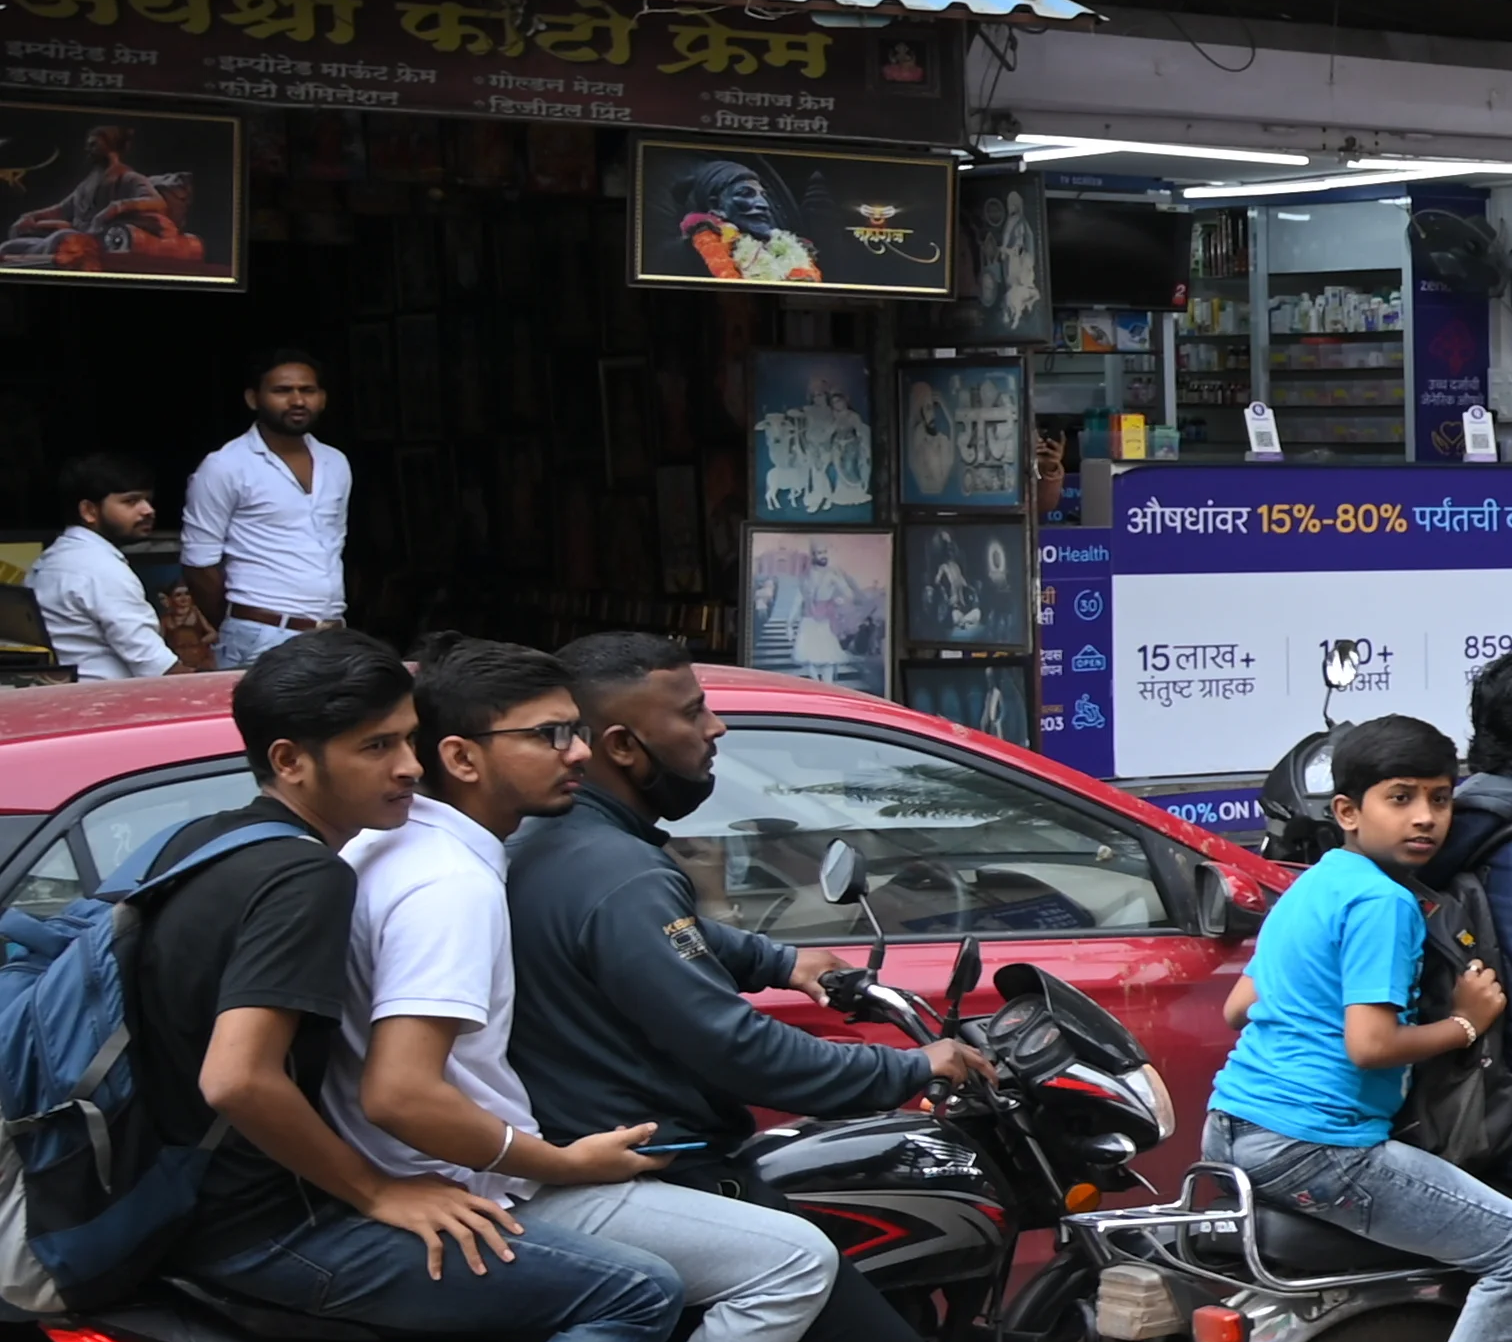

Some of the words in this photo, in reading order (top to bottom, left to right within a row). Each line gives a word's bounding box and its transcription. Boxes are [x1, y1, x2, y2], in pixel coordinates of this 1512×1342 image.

[110, 42, 158, 66] फ्रेम
[656, 6, 834, 79] फ्रेम
[80, 67, 125, 90] फ्रेम
[218, 53, 314, 80] इम्पोटेड
[321, 59, 388, 84] माऊंट
[395, 62, 437, 86] फ्रेम
[219, 77, 279, 99] फोटो
[286, 82, 399, 107] लॅमिनेशन
[488, 72, 563, 95] गोल्डन
[569, 76, 624, 98] मेटल
[489, 95, 583, 119] डिजीटल
[590, 99, 632, 123] प्रिंट
[713, 86, 792, 110] कोलाज
[796, 90, 834, 114] फ्रेम
[715, 111, 772, 132] गिफ्ट
[777, 110, 829, 134] गॅलरी
[1126, 496, 1250, 536] औषधांवर
[1257, 502, 1407, 534] 15%-80%
[1413, 497, 1499, 534] पर्यंतची
[1080, 600, 1098, 612] 30
[1136, 644, 1170, 671] 15
[1137, 676, 1193, 707] संतुष्ट
[1198, 675, 1256, 699] ग्राहक
[1219, 801, 1244, 821] ON
